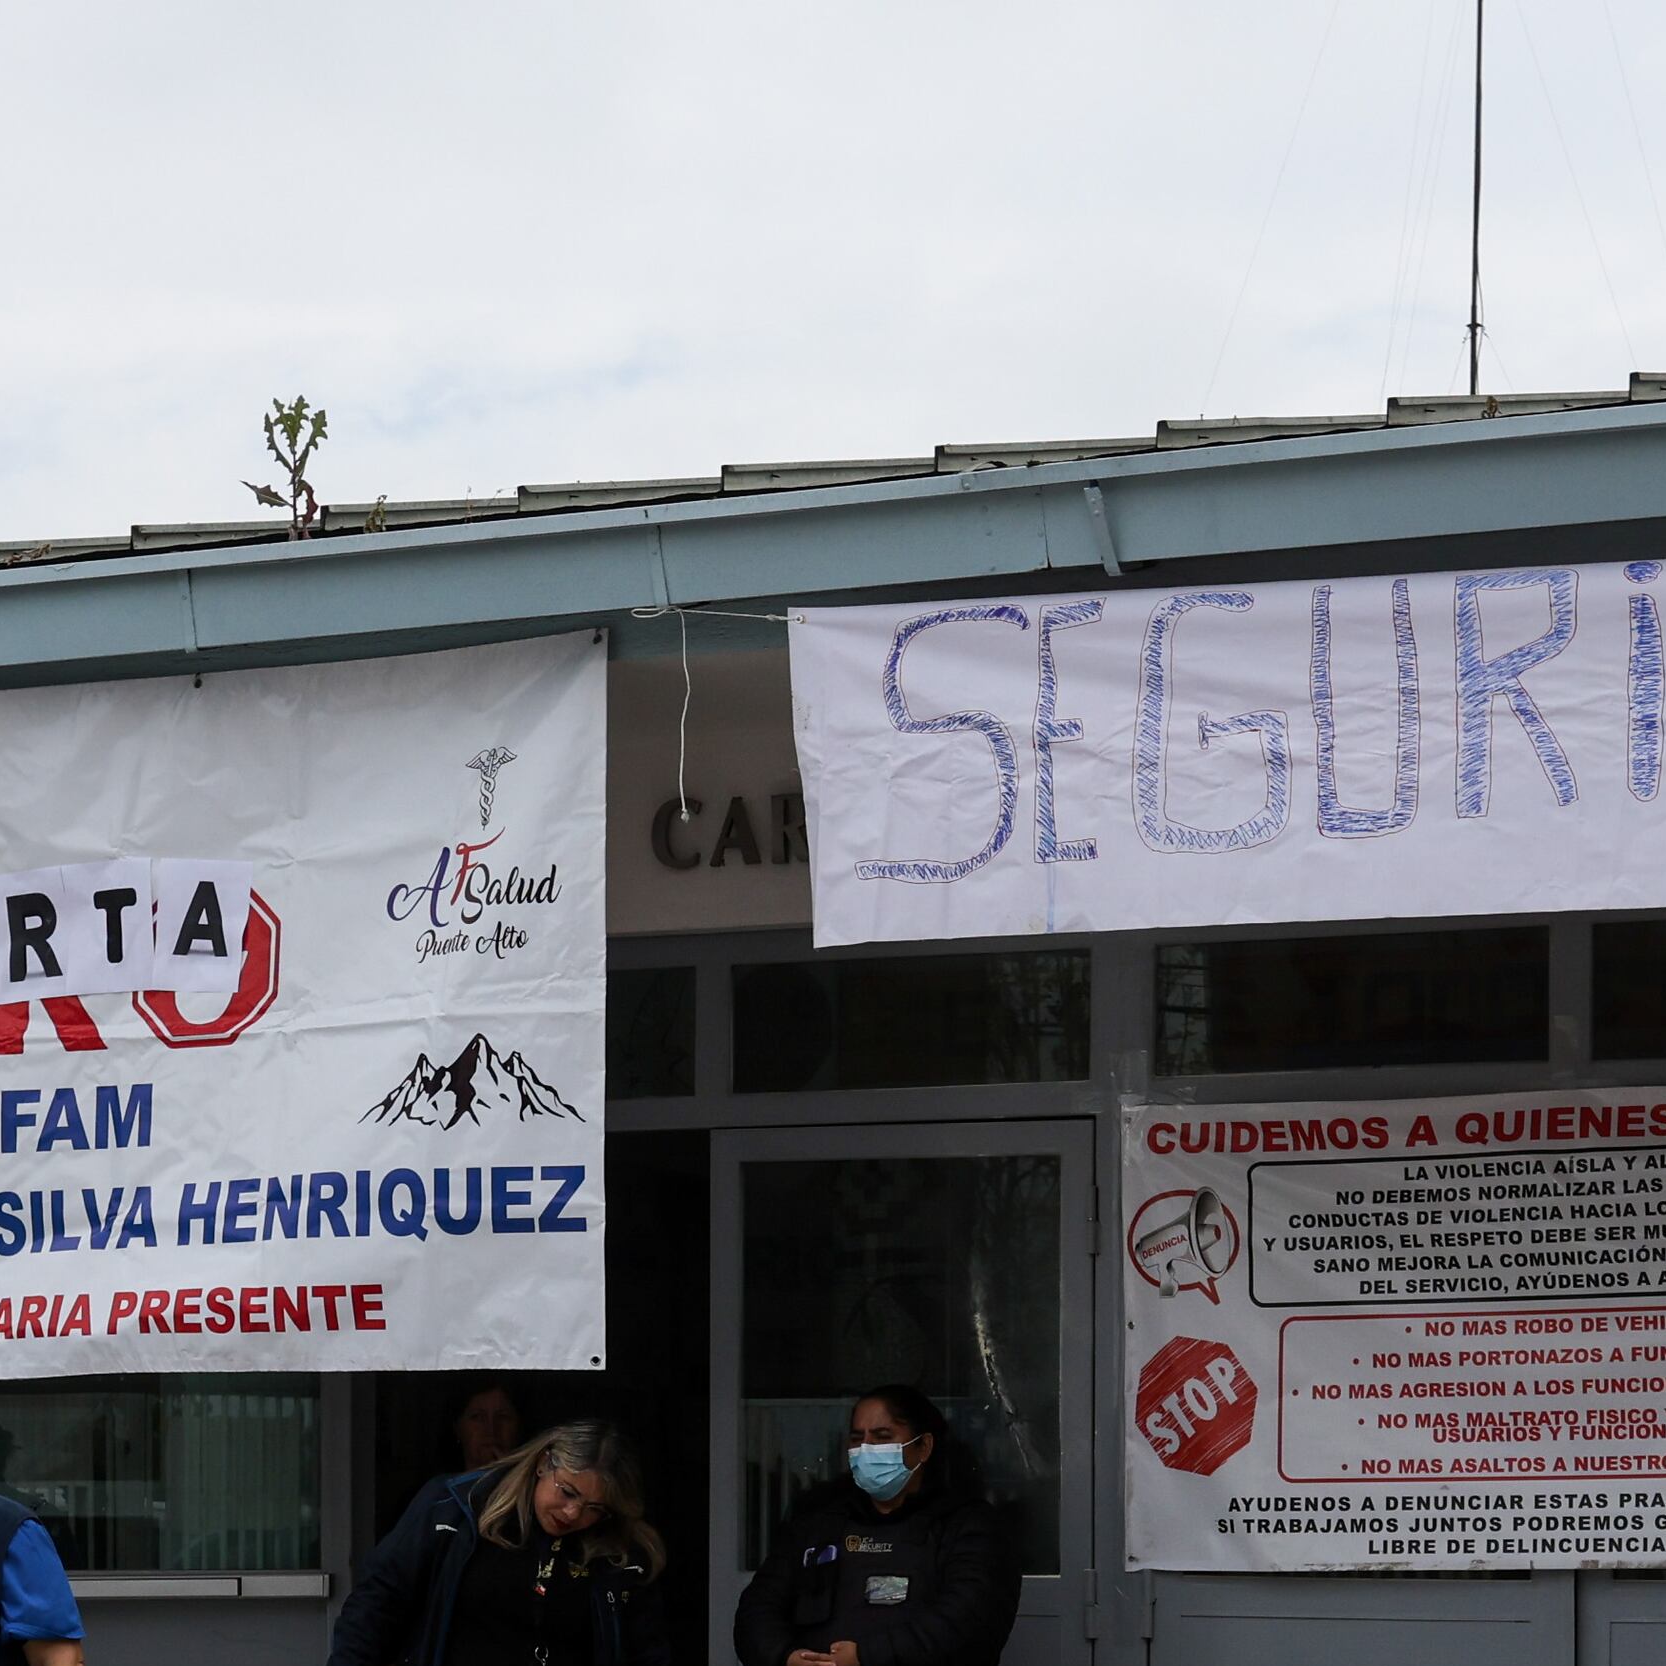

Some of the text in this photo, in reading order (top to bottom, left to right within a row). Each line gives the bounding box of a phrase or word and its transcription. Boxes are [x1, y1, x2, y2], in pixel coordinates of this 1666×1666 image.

[461, 863, 563, 925] Salud
[416, 920, 529, 965] Puente Alto
[1146, 1115, 1389, 1155] CUIDEMOS
[1405, 1115, 1439, 1148] A
[1403, 1165, 1430, 1182] LA
[1435, 1160, 1546, 1181] VIOLENCIA
[1553, 1154, 1616, 1175] AÍSLA
[1623, 1155, 1637, 1171] Y
[1335, 1190, 1365, 1206] NO
[1372, 1186, 1472, 1204] DEBEMOS
[1478, 1180, 1616, 1202] NORMALIZAR
[1623, 1178, 1664, 1195] LAS
[176, 1164, 588, 1247] HENRIQUEZ
[1288, 1210, 1409, 1229] CONDUCTAS
[1416, 1209, 1443, 1226] DE
[1450, 1204, 1564, 1225] VIOLENCIA
[1570, 1202, 1637, 1220] HACIA
[1142, 1234, 1188, 1260] DENUNCIA
[1263, 1237, 1276, 1252] Y
[1283, 1234, 1395, 1253] USUARIOS,
[1399, 1233, 1424, 1249] EL
[1430, 1230, 1524, 1249] RESPETO
[1531, 1227, 1587, 1244] DEBE
[1593, 1224, 1637, 1242] SER
[1313, 1257, 1372, 1274] SANO
[1377, 1254, 1462, 1273] MEJORA
[1467, 1252, 1494, 1269] LA
[1359, 1279, 1400, 1296] DEL
[1405, 1275, 1510, 1296] SERVICIO,
[1515, 1269, 1631, 1292] AYÚDENOS
[1637, 1270, 1652, 1286] A
[106, 1283, 387, 1335] PRESENTE
[1424, 1321, 1456, 1337] NO
[1462, 1319, 1508, 1336] MAS
[1514, 1317, 1574, 1335] ROBO
[1580, 1316, 1609, 1333] DE
[1372, 1352, 1402, 1368] NO
[1408, 1351, 1453, 1368] MAS
[1458, 1347, 1604, 1367] PORTONAZOS
[1609, 1347, 1625, 1363] A
[1311, 1384, 1342, 1400] NO
[1348, 1383, 1393, 1400] MAS
[1399, 1380, 1506, 1398] AGRESION
[1513, 1380, 1528, 1396] A
[1533, 1378, 1575, 1396] LOS
[1146, 1357, 1238, 1454] STOP
[1377, 1413, 1408, 1429] NO
[1414, 1412, 1460, 1429] MAS
[1466, 1409, 1579, 1428] MALTRATO
[1585, 1407, 1658, 1426] FISICO
[1433, 1426, 1542, 1444] USUARIOS
[1547, 1425, 1562, 1441] Y
[1361, 1459, 1392, 1475] NO
[1398, 1458, 1444, 1474] MAS
[1449, 1456, 1547, 1474] ASALTOS
[1552, 1456, 1568, 1472] A
[1228, 1496, 1352, 1513] AYUDENOS
[1360, 1496, 1376, 1512] A
[1385, 1494, 1525, 1512] DENUNCIAR
[1533, 1492, 1609, 1510] ESTAS
[1217, 1518, 1235, 1534] SI
[1242, 1517, 1399, 1534] TRABAJAMOS
[1408, 1516, 1503, 1533] JUNTOS
[1512, 1514, 1645, 1533] PODREMOS
[1368, 1539, 1437, 1556] LIBRE
[1446, 1539, 1476, 1554] DE
[1485, 1536, 1666, 1555] DELINCUENCIA
